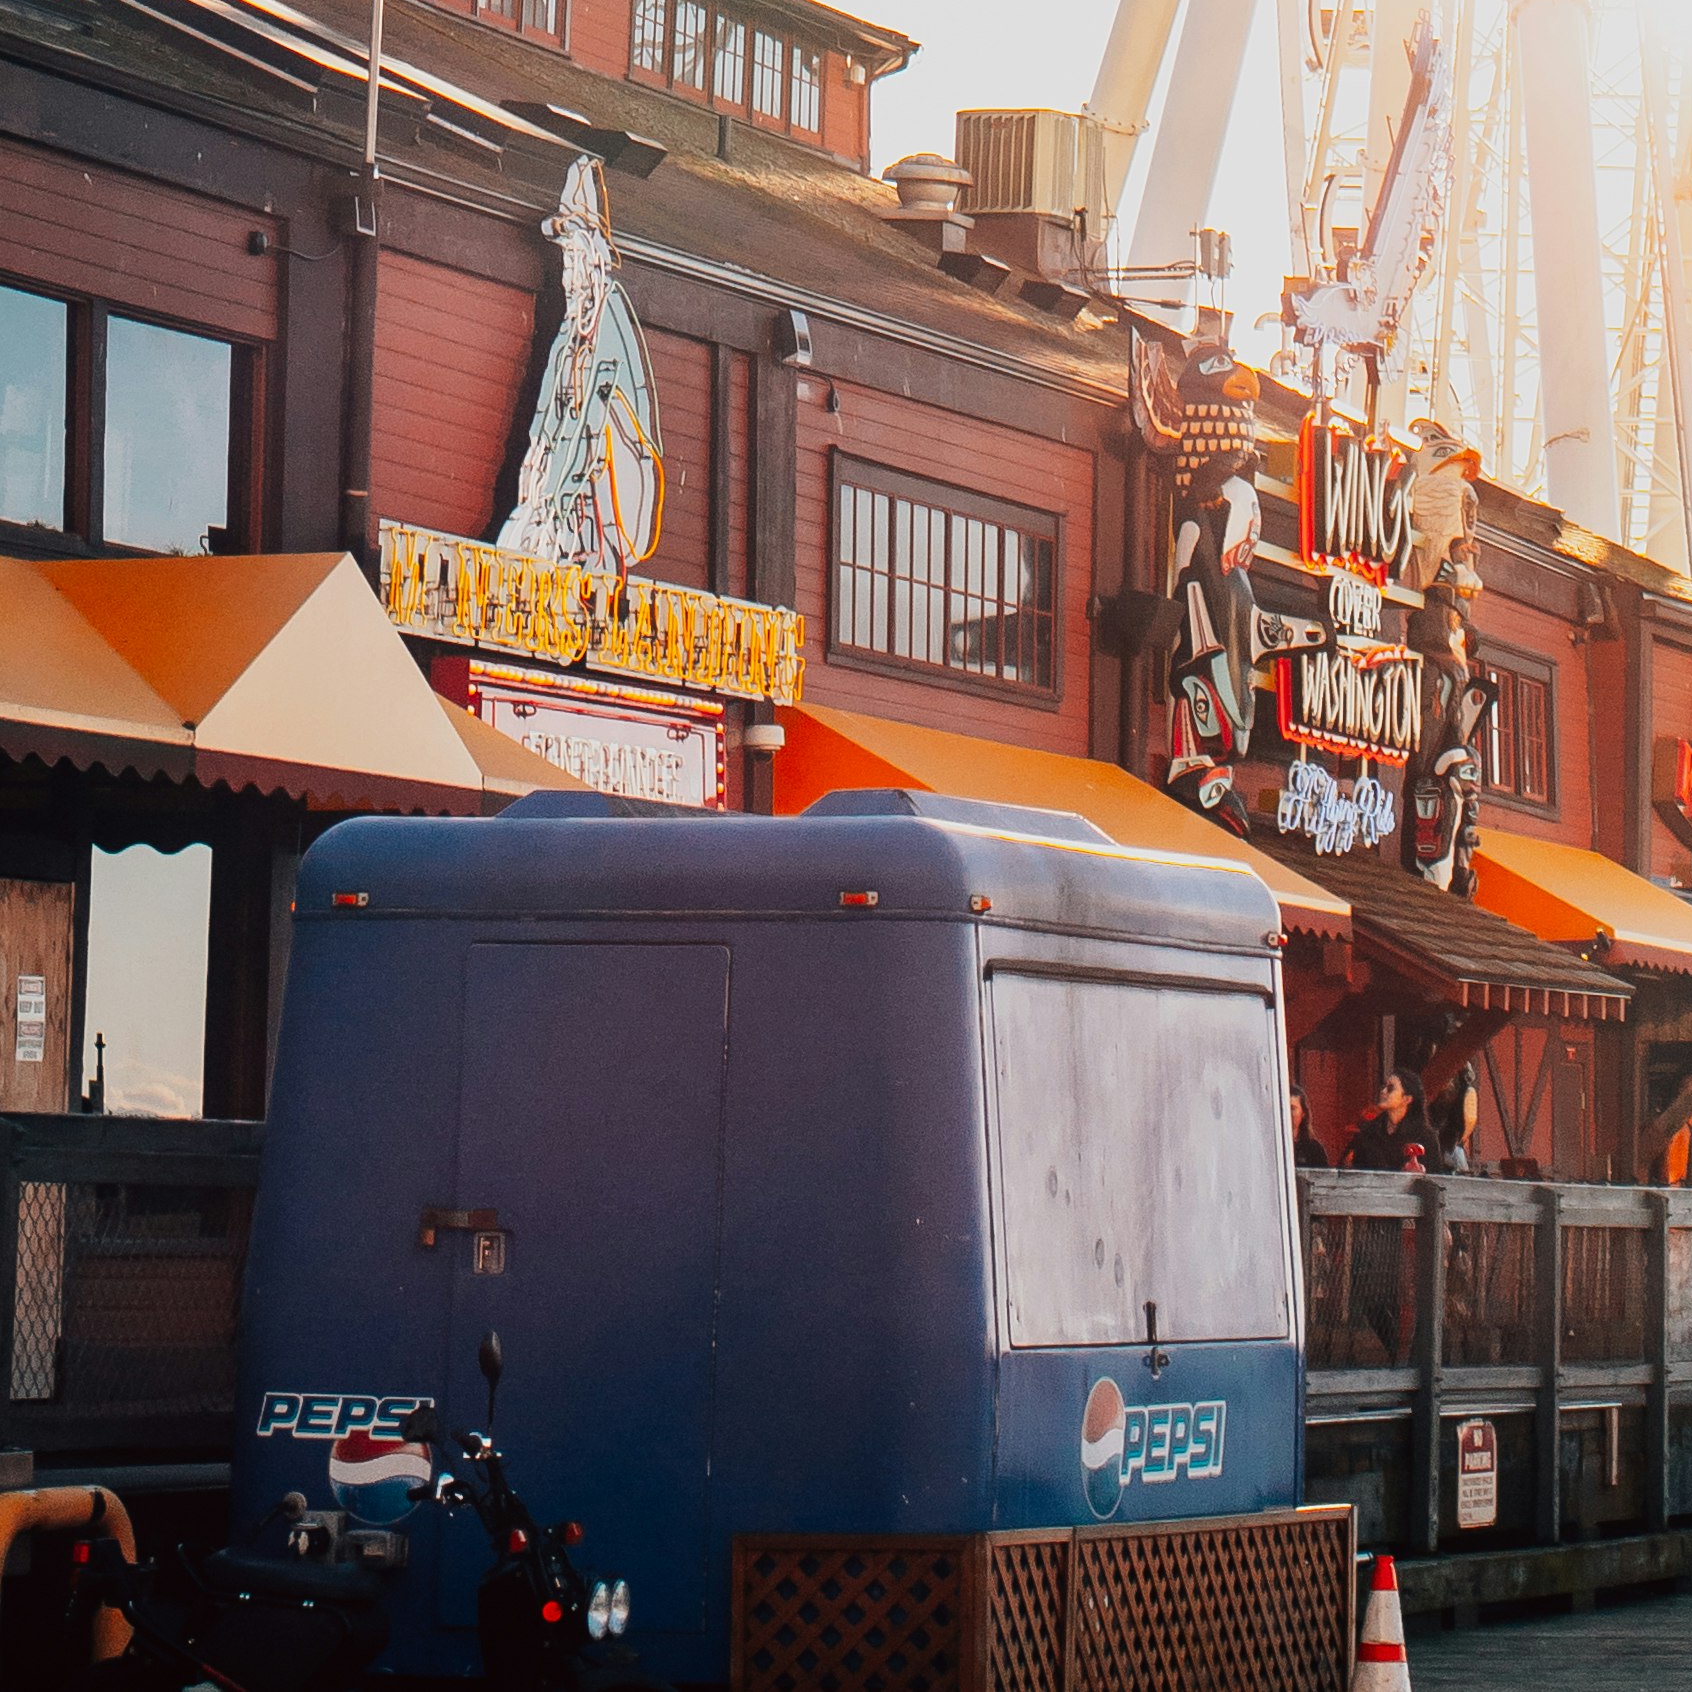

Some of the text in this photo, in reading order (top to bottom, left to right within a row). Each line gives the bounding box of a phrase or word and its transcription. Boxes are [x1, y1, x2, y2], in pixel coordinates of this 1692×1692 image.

[1325, 425, 1417, 573] WINGS
[1300, 650, 1422, 753] WASHINGTON
[256, 1391, 435, 1442] PEPS
[1119, 1399, 1227, 1487] PEPSI
